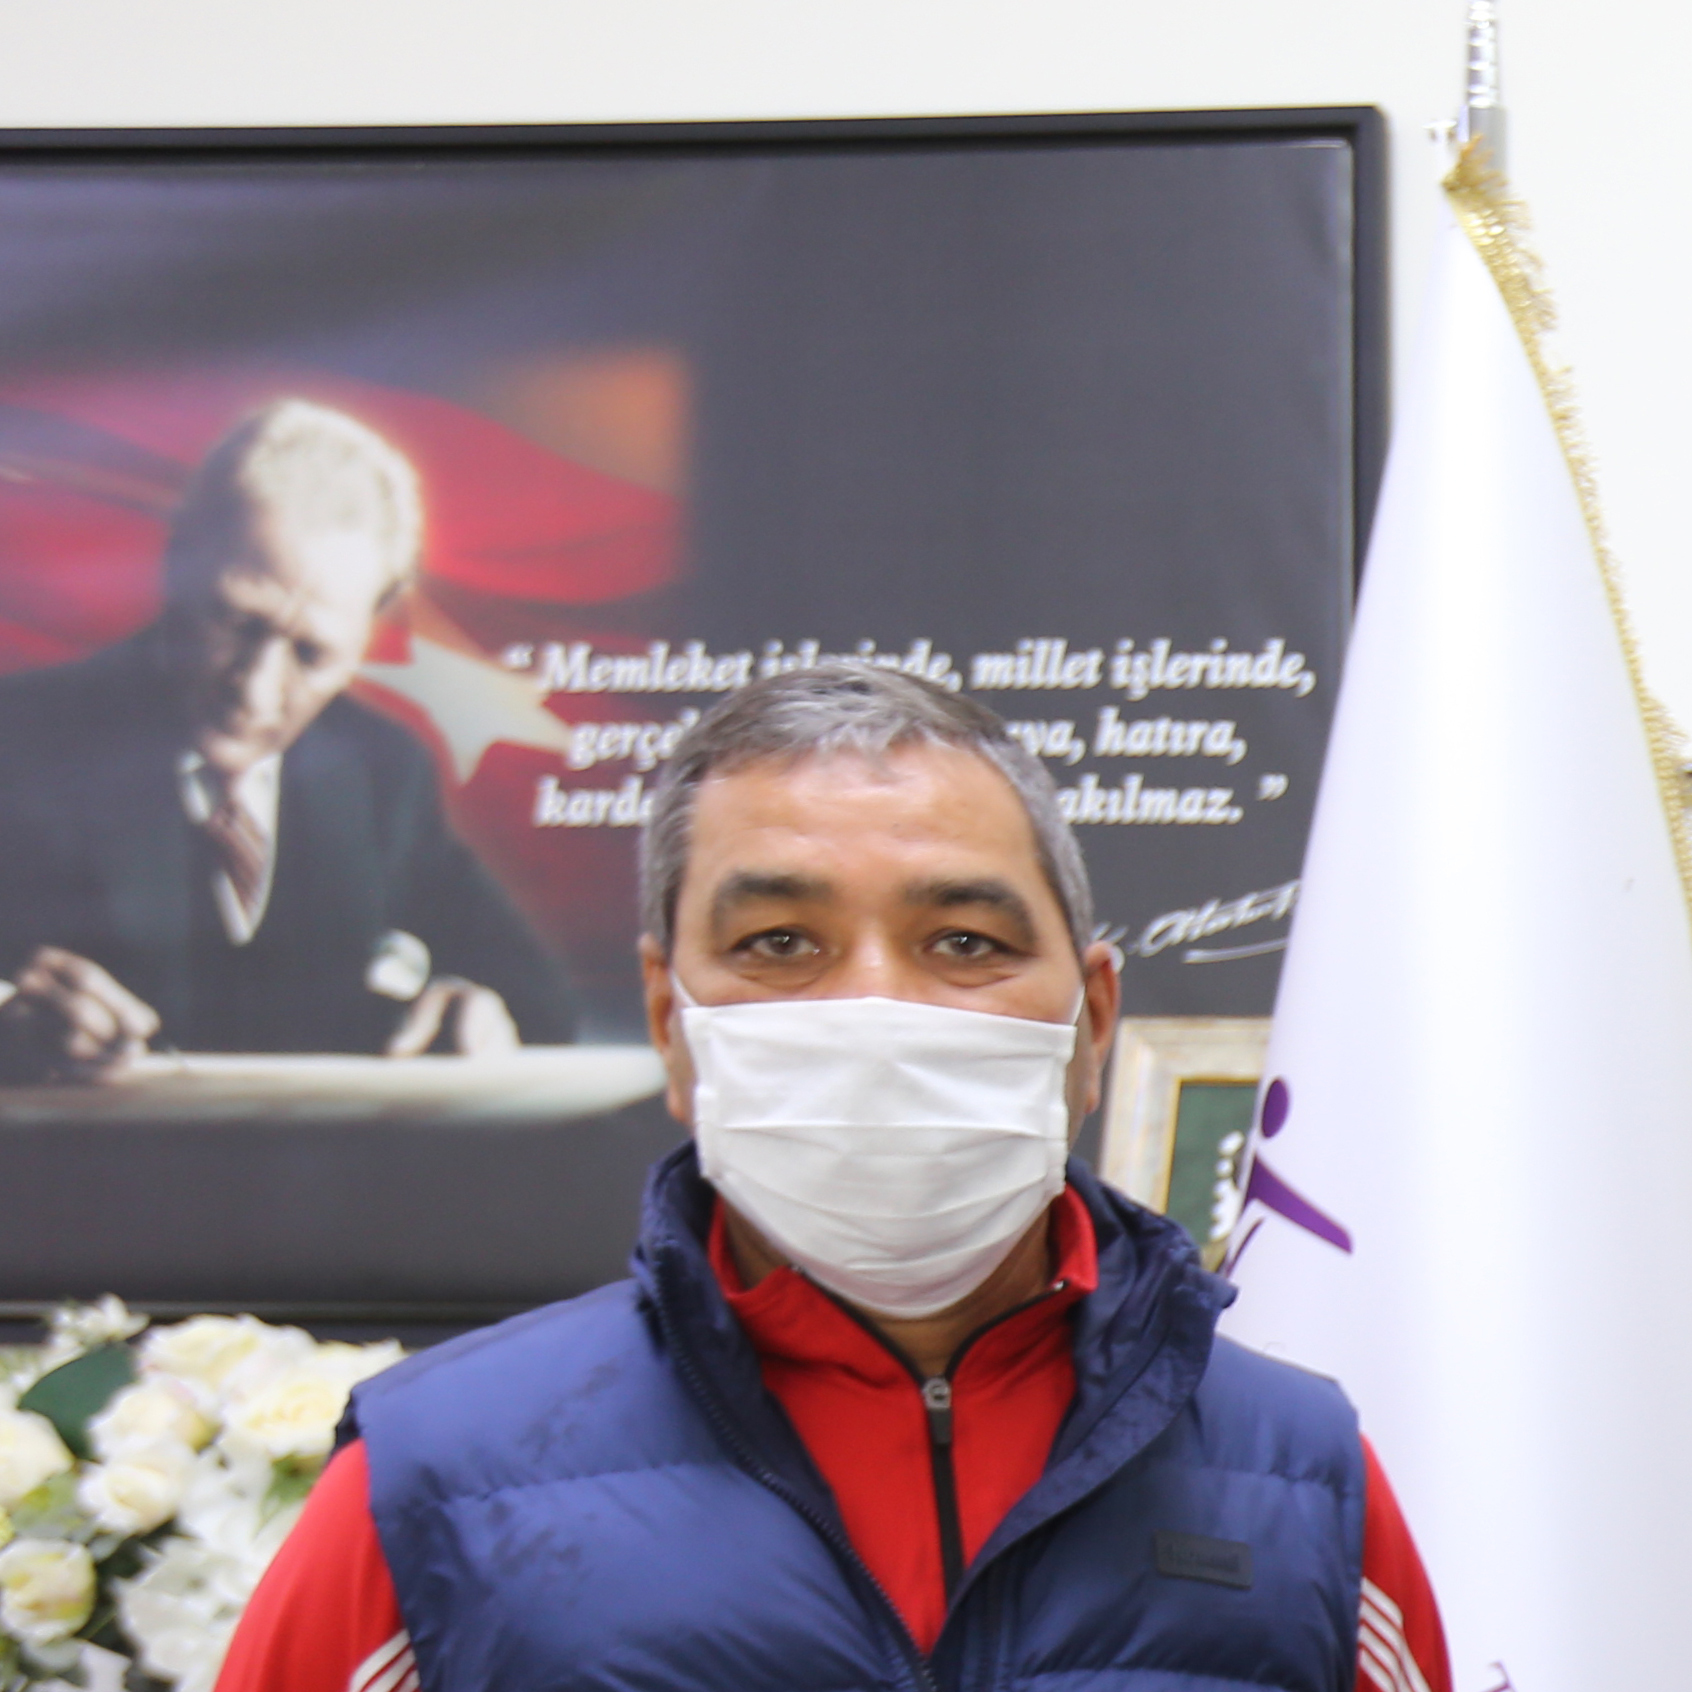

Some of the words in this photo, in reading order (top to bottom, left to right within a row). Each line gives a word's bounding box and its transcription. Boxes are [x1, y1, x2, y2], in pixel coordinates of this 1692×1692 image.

[537, 638, 754, 692] Memleket
[970, 636, 1105, 690] millet
[1109, 636, 1316, 700] işlerinde,
[564, 707, 701, 772] gerçe
[1095, 704, 1248, 766] hatıra,
[1055, 772, 1245, 825] akılmaz.
